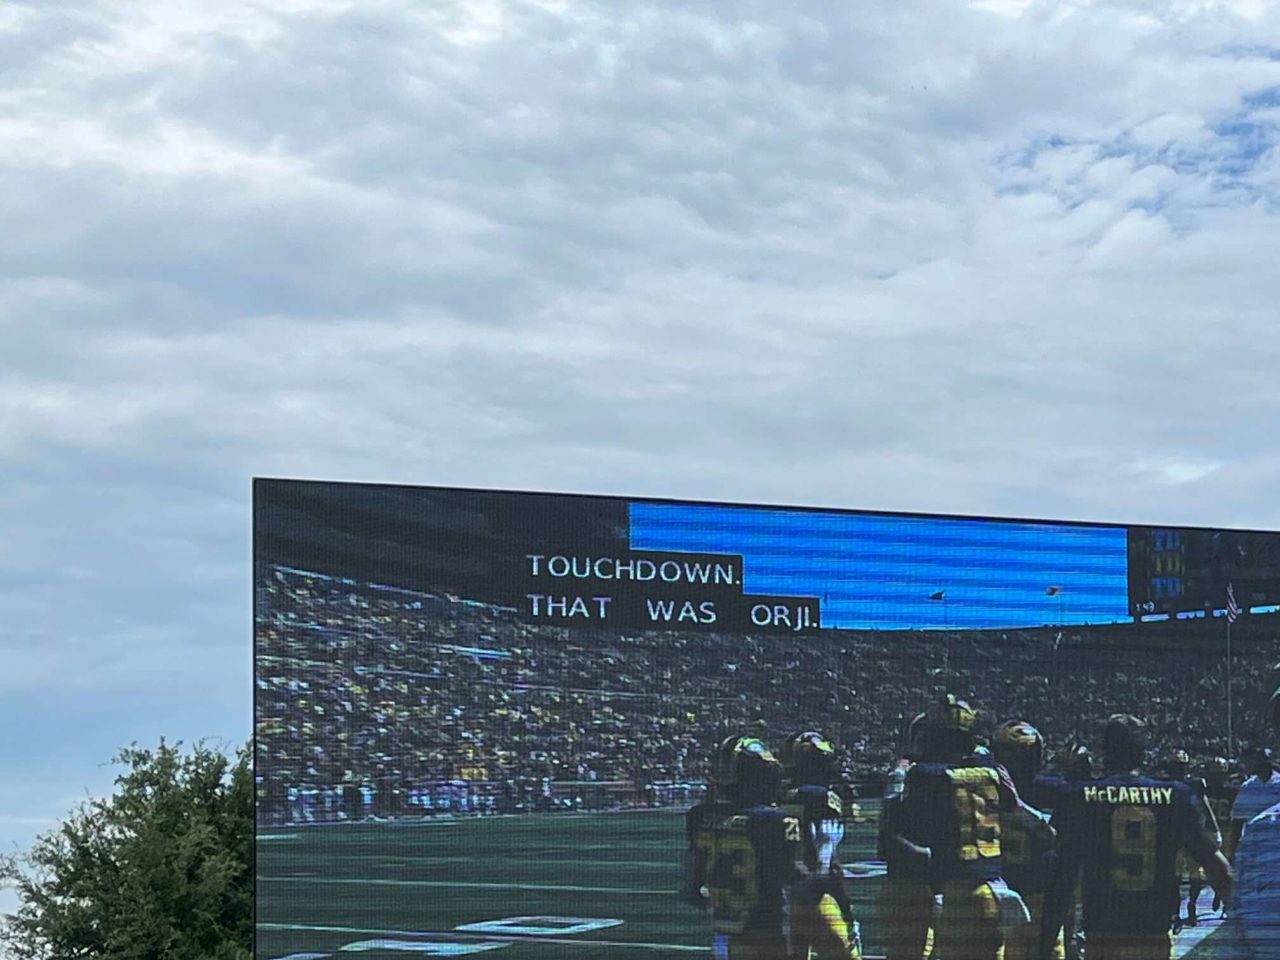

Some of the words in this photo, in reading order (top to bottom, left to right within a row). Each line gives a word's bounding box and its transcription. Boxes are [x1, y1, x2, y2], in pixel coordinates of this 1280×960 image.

[526, 554, 741, 585] TOUCHDOWN.
[526, 594, 611, 618] THAT
[646, 598, 717, 624] WAS
[750, 604, 817, 631] ORJI.
[1084, 786, 1173, 805] McCARTHY
[1111, 805, 1158, 891] 9
